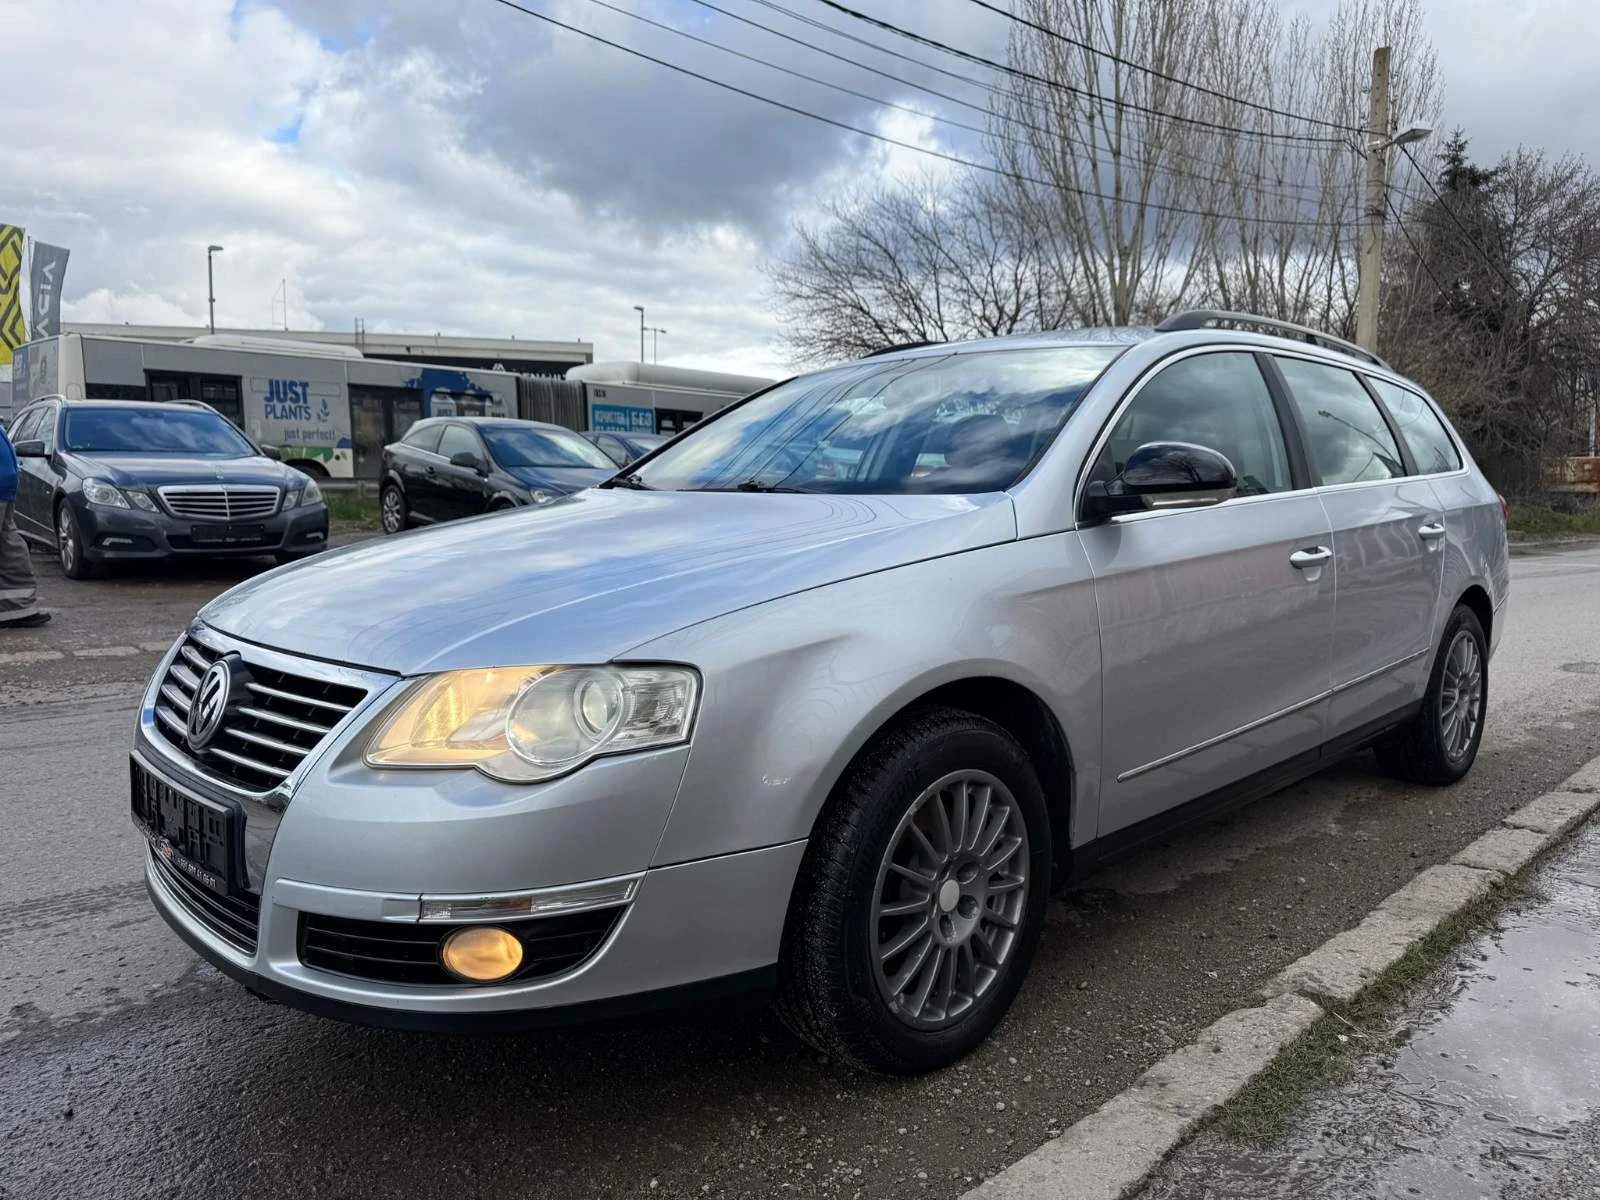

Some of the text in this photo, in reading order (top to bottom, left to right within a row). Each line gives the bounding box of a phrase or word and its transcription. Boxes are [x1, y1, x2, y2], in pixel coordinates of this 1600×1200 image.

[36, 261, 57, 338] ACIA
[264, 379, 309, 404] JUST
[264, 404, 311, 420] PLANTS
[284, 428, 300, 441] just
